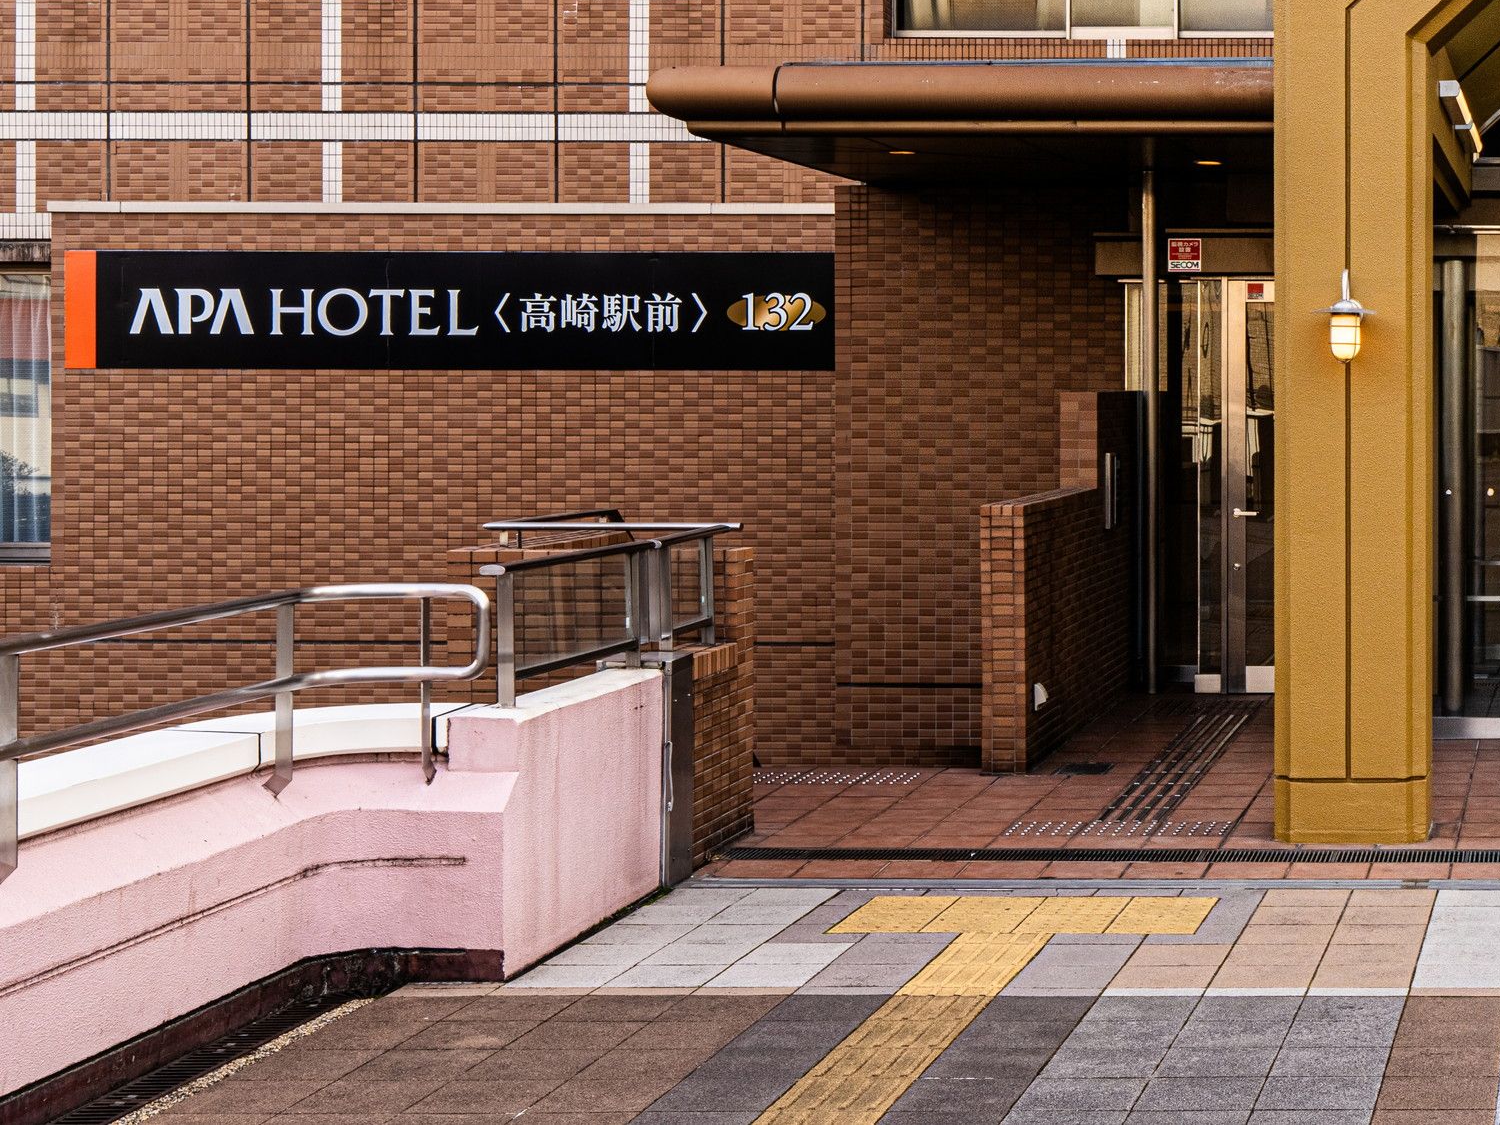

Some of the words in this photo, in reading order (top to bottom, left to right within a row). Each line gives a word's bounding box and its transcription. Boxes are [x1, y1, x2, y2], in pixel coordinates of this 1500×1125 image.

[1170, 261, 1199, 269] SECOM
[130, 288, 254, 335] APA
[270, 288, 478, 336] HOTEL
[740, 292, 814, 331] 132
